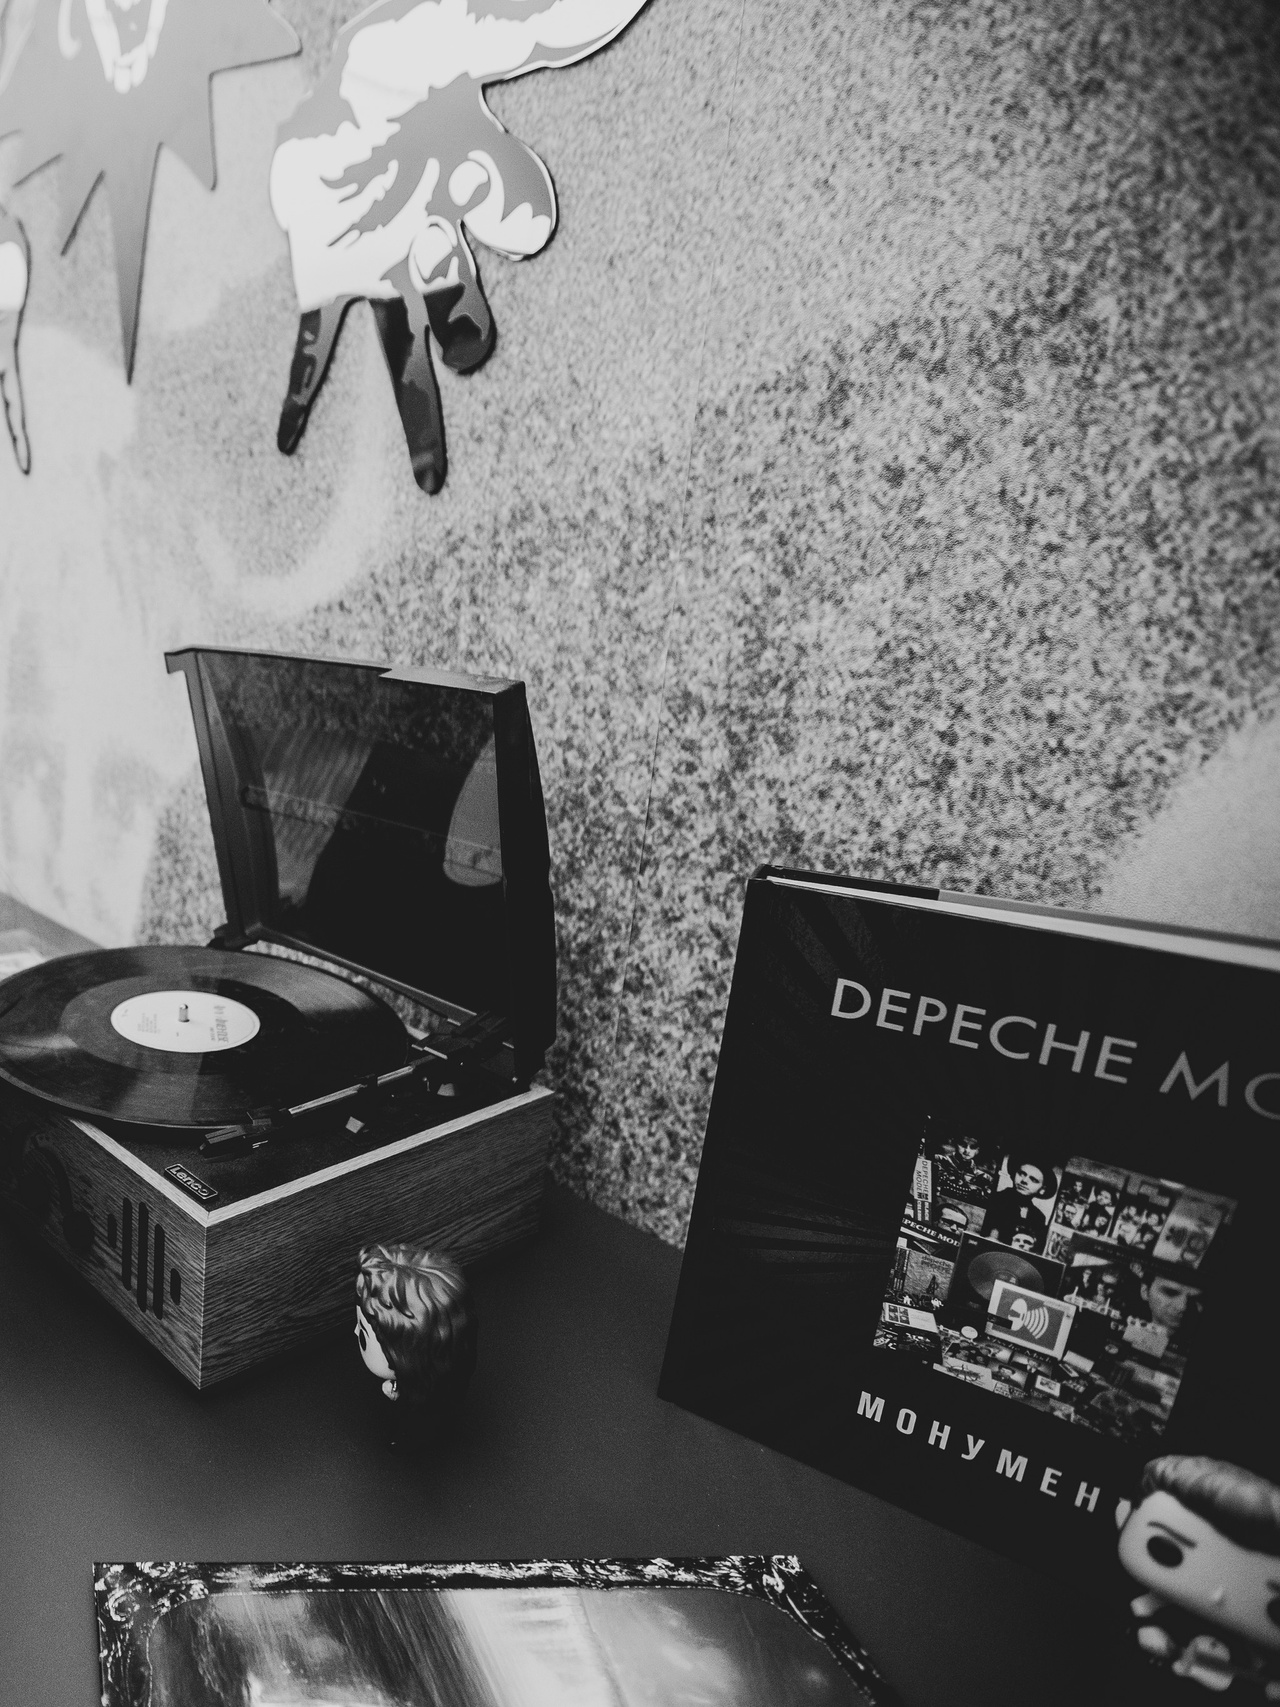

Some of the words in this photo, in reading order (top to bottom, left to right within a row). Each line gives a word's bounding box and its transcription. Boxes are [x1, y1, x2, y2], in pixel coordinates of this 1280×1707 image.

[830, 977, 1138, 1085] DEPECHE
[169, 1166, 210, 1197] Lenco
[856, 1390, 1130, 1513] МОНУМЕН
